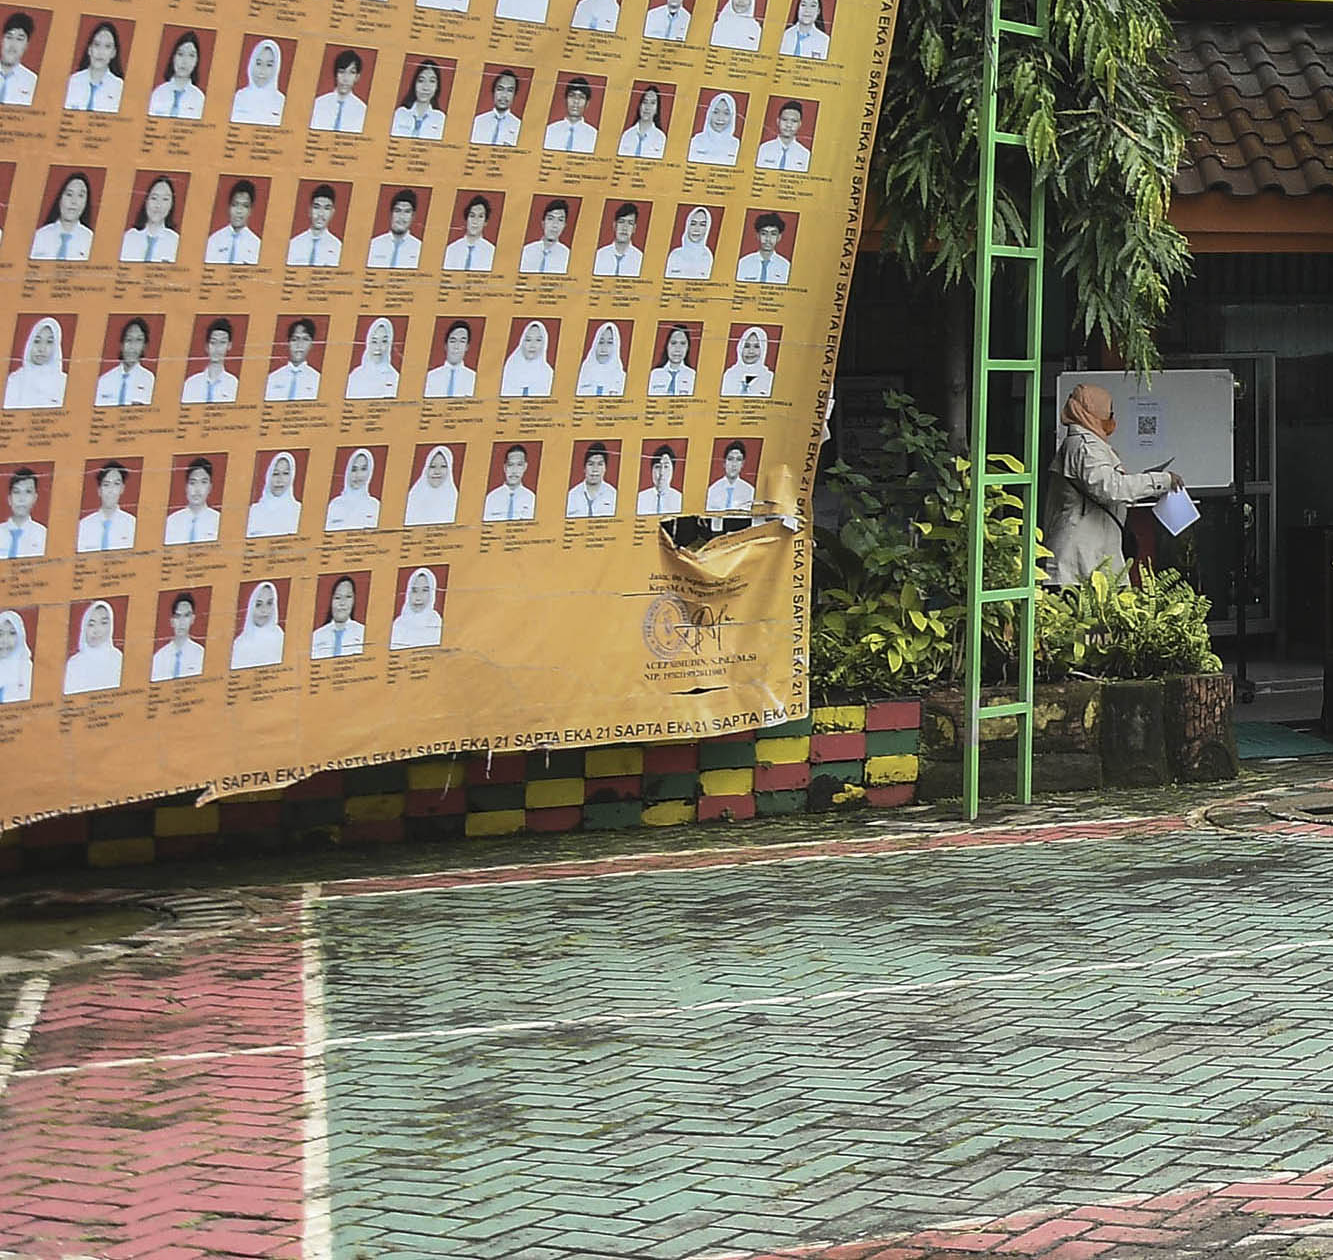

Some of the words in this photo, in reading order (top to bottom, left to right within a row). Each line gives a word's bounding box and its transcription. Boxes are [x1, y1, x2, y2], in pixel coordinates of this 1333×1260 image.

[875, 17, 890, 47] EKA
[871, 50, 884, 65] 21
[863, 71, 881, 118] SAPTA
[858, 123, 872, 152] EKA
[855, 156, 867, 170] 21
[848, 176, 864, 224] SAPTA
[842, 227, 856, 258] EKA
[838, 263, 851, 277] 21
[829, 283, 848, 331] SAPTA
[824, 334, 838, 365] EKA
[820, 369, 831, 384] 21
[810, 390, 829, 438] SAPTA
[804, 443, 818, 473] EKA
[800, 476, 811, 491] 21
[793, 540, 805, 570] EKA
[792, 574, 804, 589] 21
[792, 594, 804, 642] SAPTA
[792, 647, 804, 678] EKA
[791, 682, 802, 696] 21
[222, 770, 270, 790] SAPTA
[460, 737, 489, 749] EKA
[494, 735, 508, 748] 21
[514, 731, 559, 746] SAPTA
[564, 728, 592, 742] EKA
[596, 726, 610, 738] 21
[614, 722, 662, 738] SAPTA
[667, 720, 693, 733] EKA
[695, 720, 706, 732] 21
[712, 712, 758, 730] SAPTA
[790, 703, 803, 716] 21
